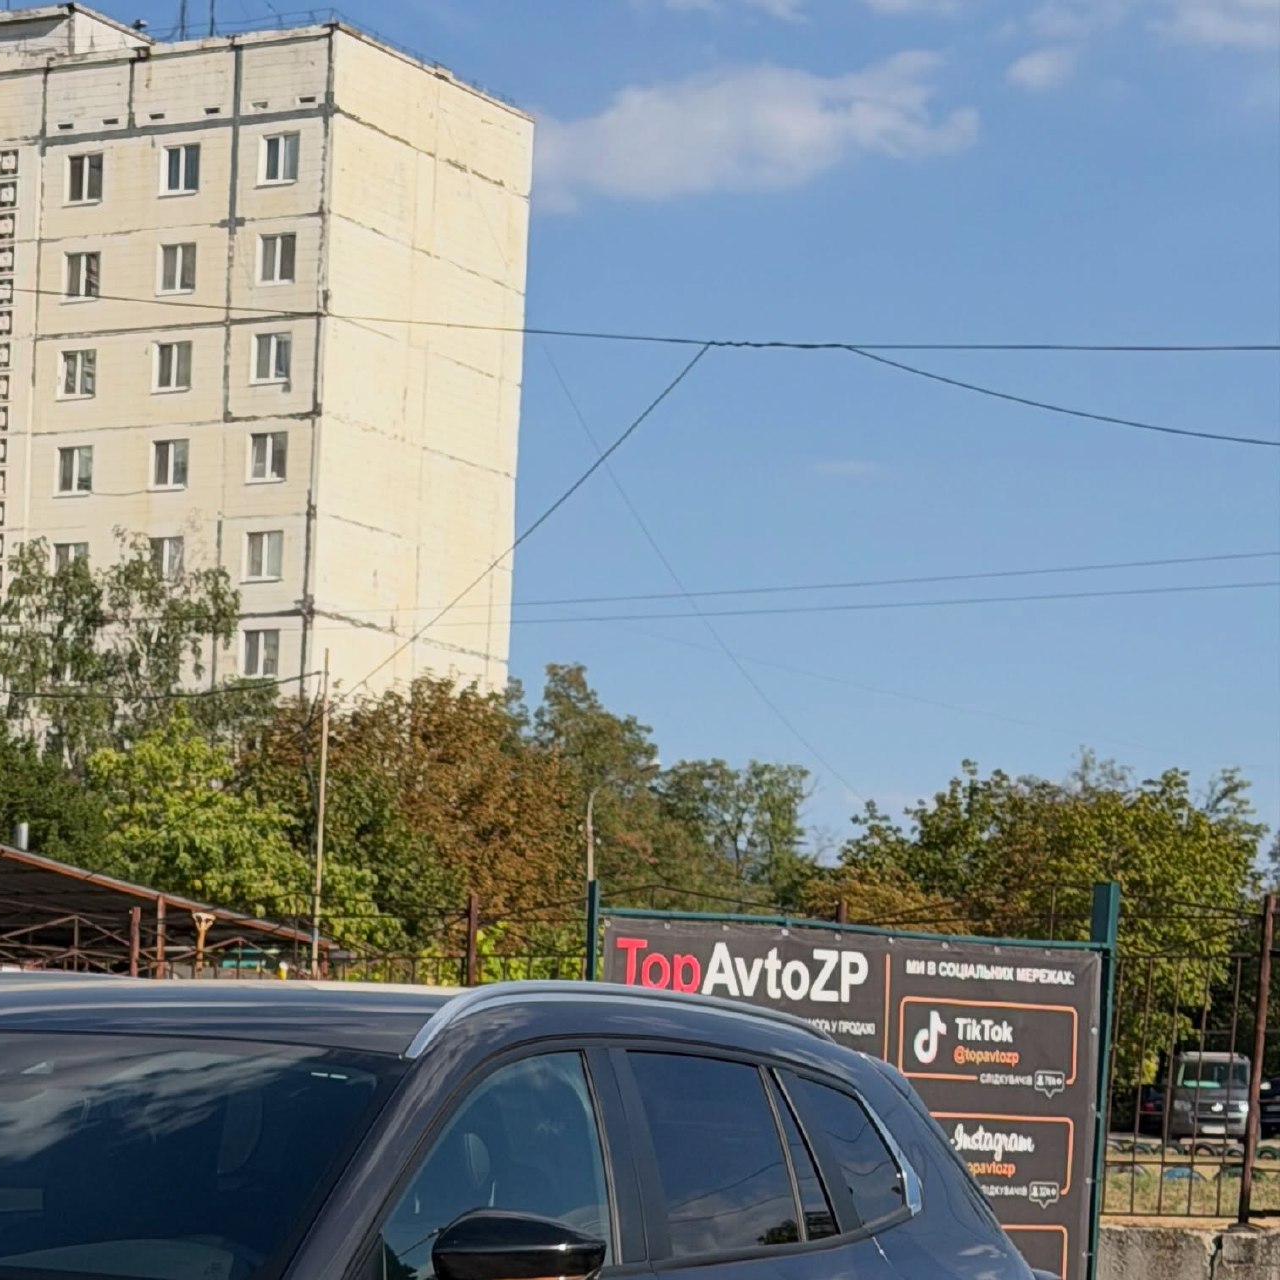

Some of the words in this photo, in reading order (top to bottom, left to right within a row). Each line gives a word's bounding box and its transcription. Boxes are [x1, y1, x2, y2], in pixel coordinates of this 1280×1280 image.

[927, 961, 936, 976] В
[938, 961, 1015, 981] СОЦІАЛЬНИХ
[954, 1017, 1014, 1043] TikTok
[953, 1045, 1019, 1067] @topavtozp
[950, 1123, 1035, 1162] Instagram
